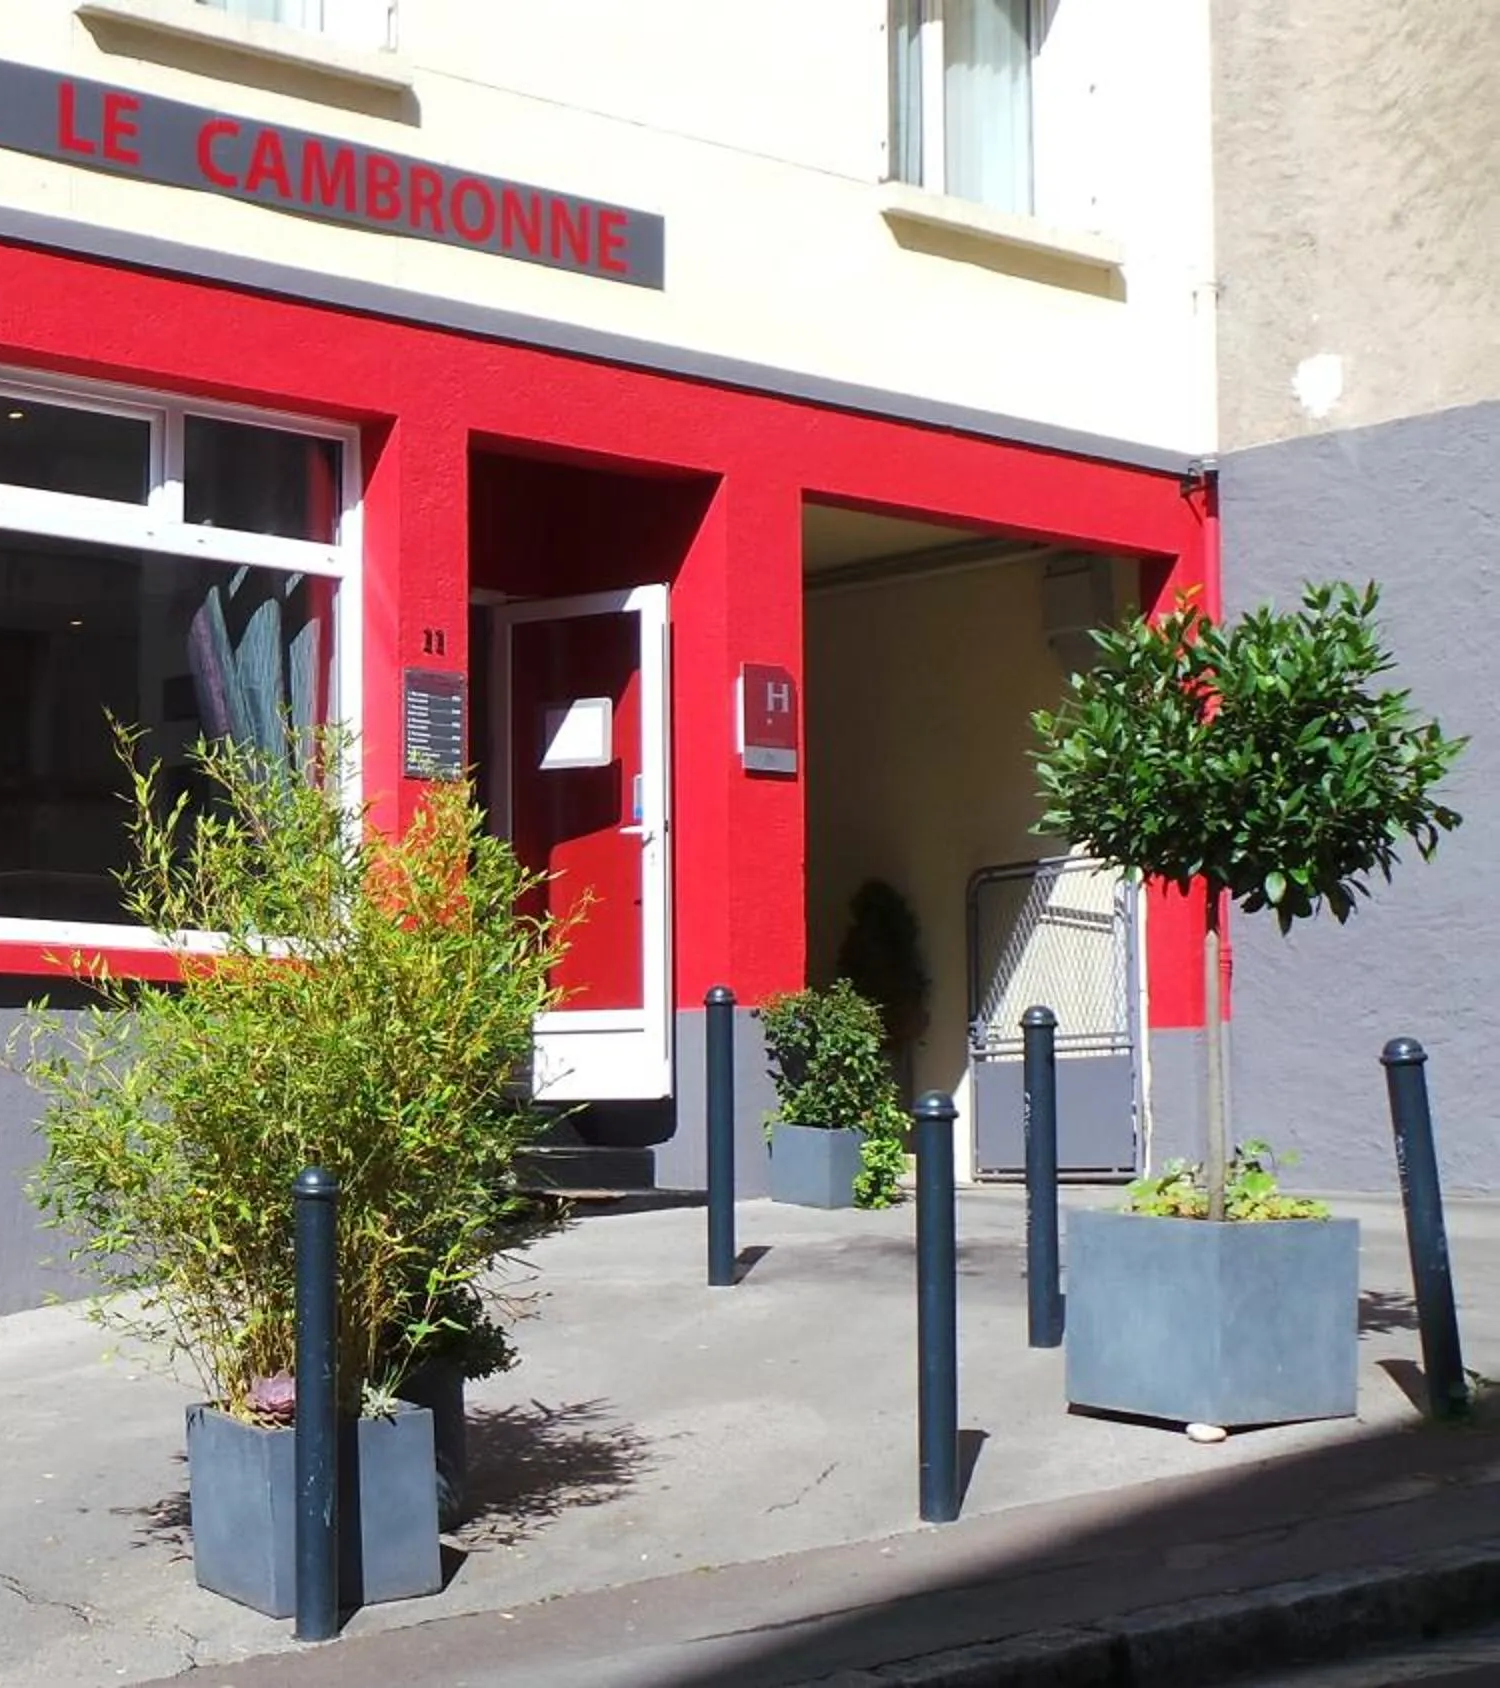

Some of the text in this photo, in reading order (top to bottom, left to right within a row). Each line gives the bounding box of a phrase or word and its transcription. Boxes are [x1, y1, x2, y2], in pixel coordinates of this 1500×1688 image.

[56, 81, 141, 165] LE
[195, 118, 629, 274] CAMBRONNE
[422, 628, 446, 656] 11
[766, 682, 790, 713] H
